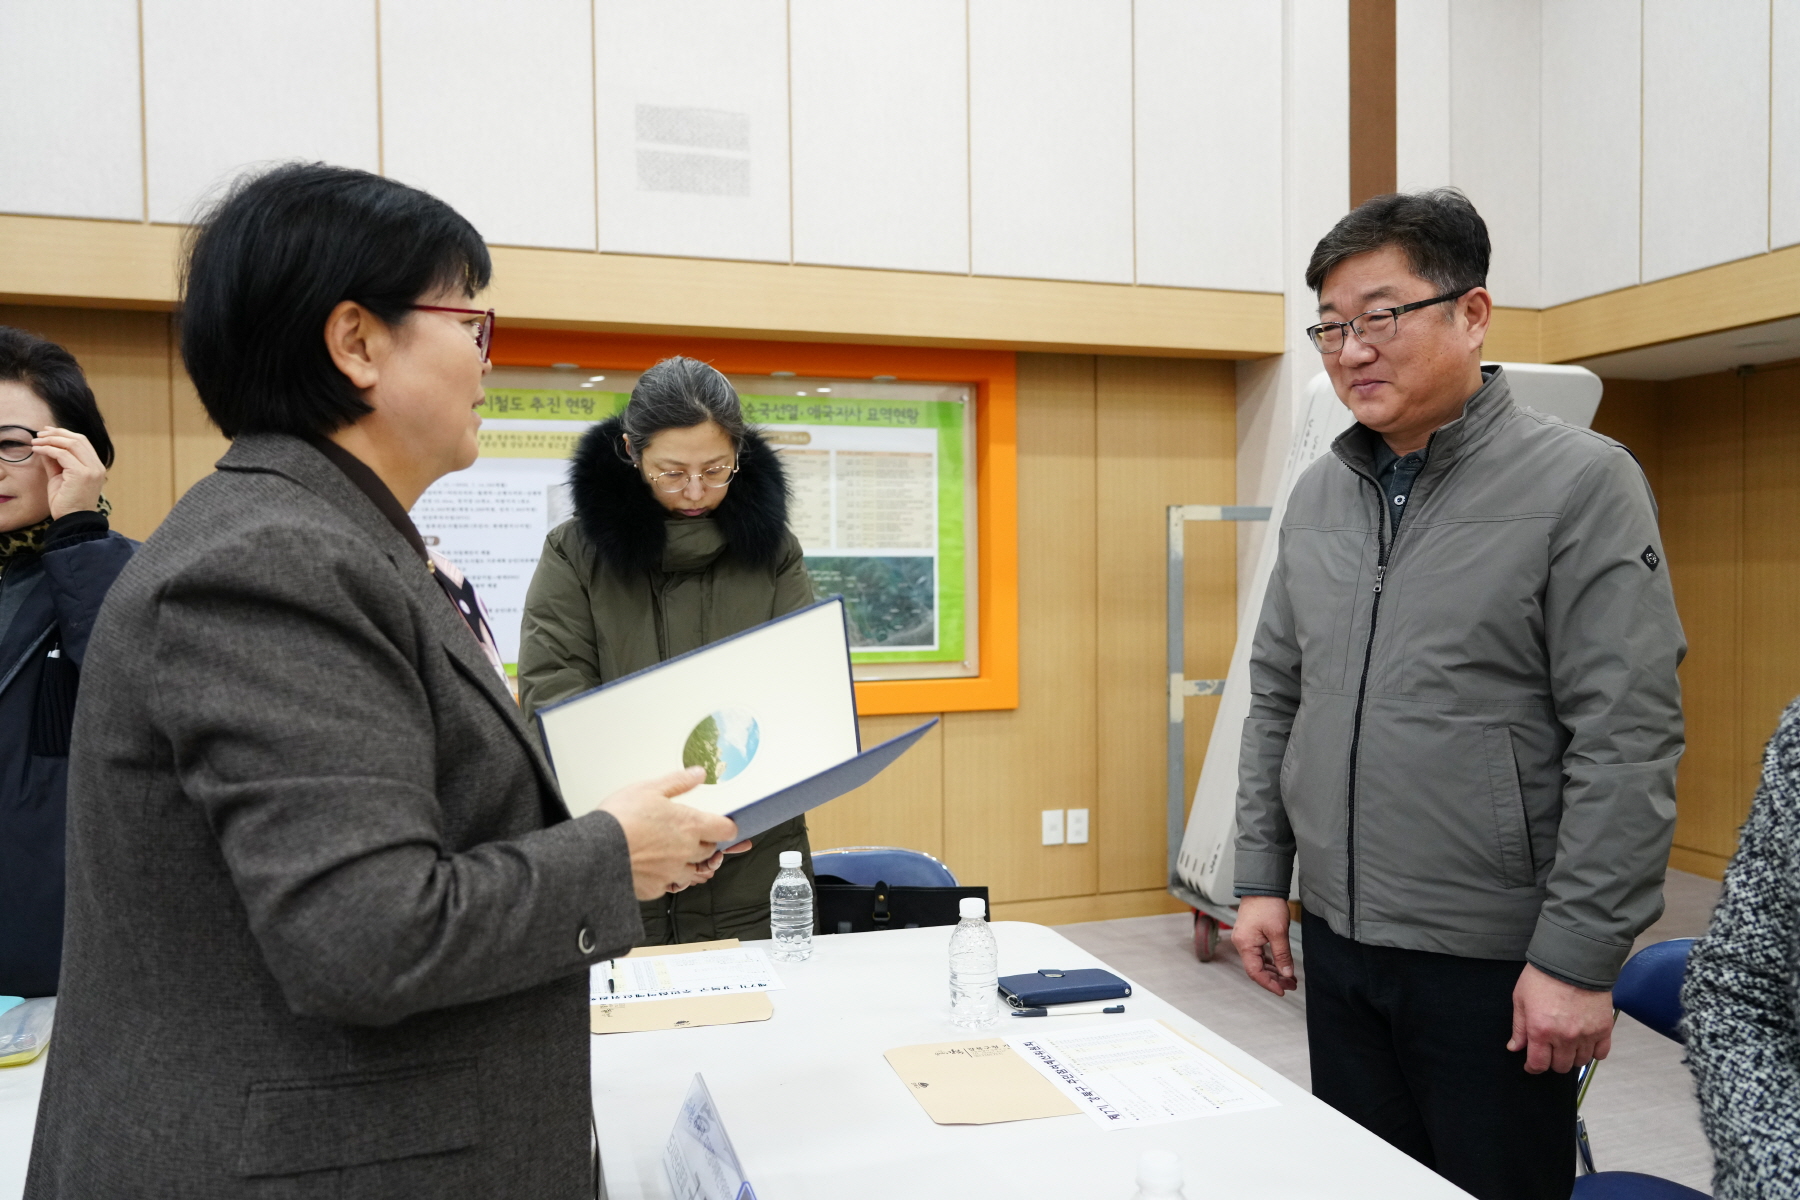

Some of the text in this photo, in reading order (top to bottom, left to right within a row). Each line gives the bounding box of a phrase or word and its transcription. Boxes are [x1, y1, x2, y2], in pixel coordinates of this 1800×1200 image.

[530, 396, 561, 414] 추진
[565, 396, 597, 415] 현황
[1074, 1086, 1101, 1102] 강북구
